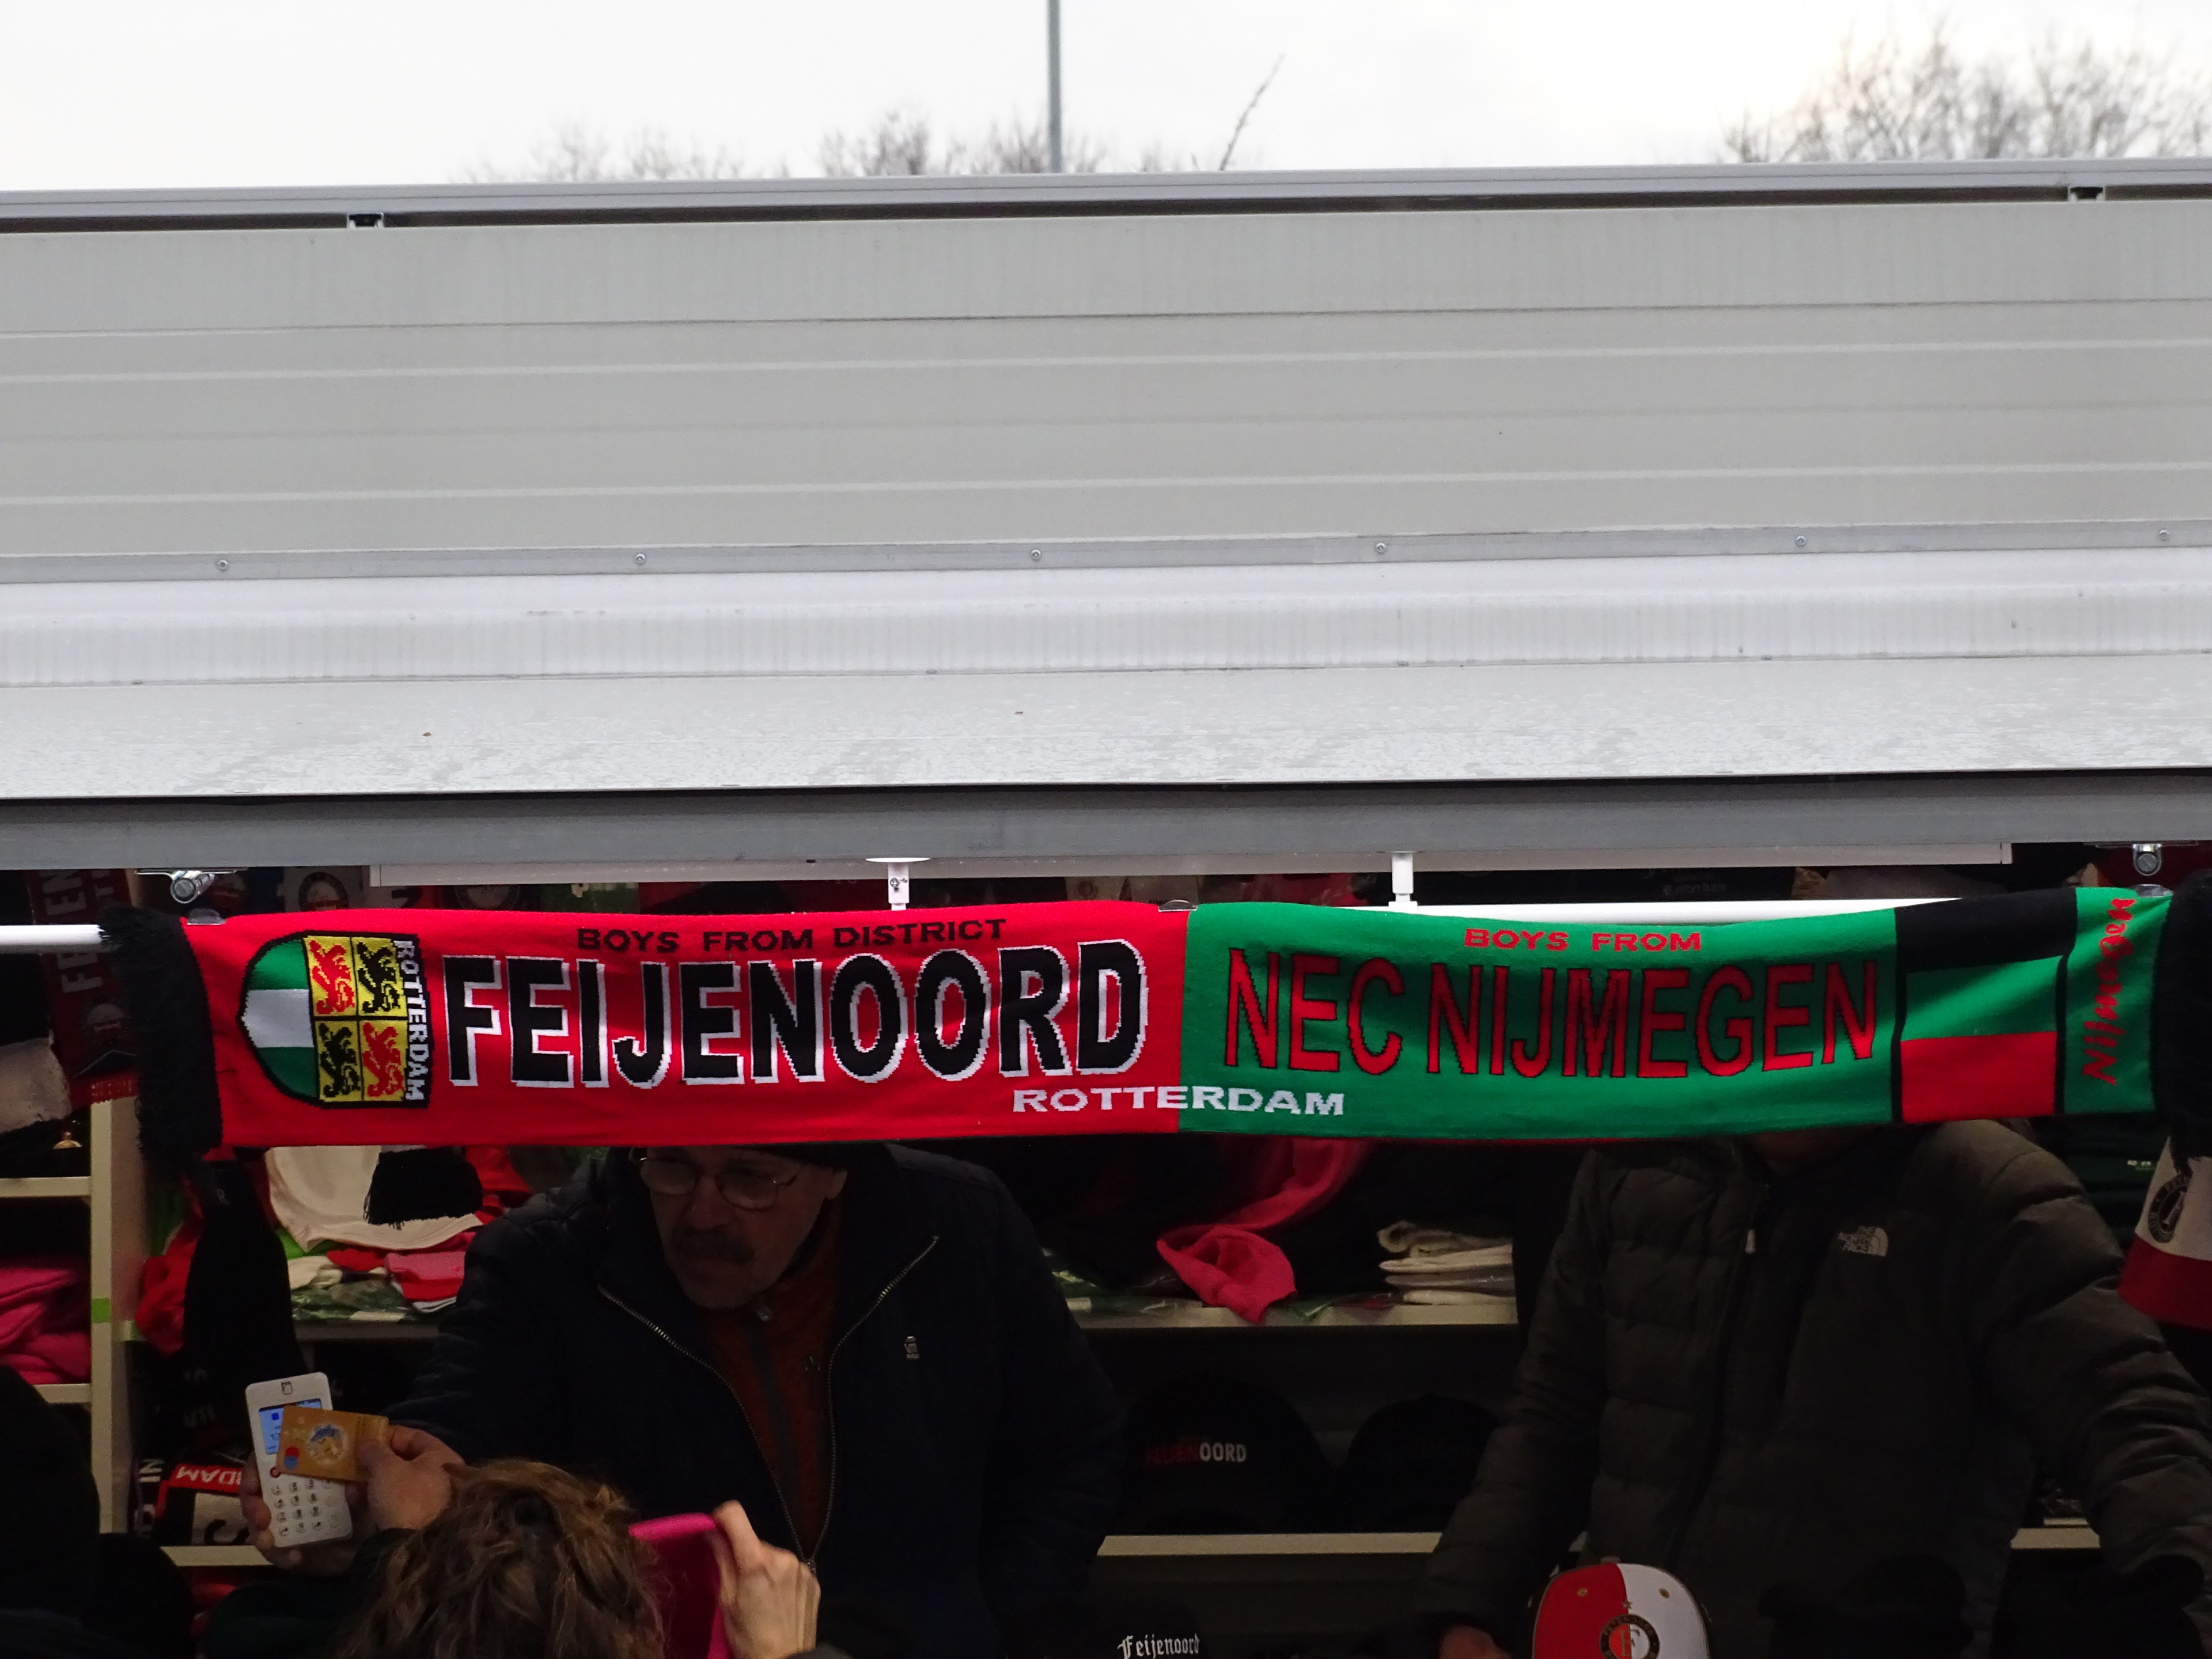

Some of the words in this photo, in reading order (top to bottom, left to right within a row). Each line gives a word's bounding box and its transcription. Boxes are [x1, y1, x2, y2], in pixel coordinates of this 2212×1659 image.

[577, 928, 679, 953] BOYS
[703, 929, 813, 952] FROM
[834, 919, 1006, 948] DISTRICT
[1463, 927, 1569, 952] BOYS
[1590, 932, 1702, 952] FROM
[393, 940, 428, 1101] ROTTERDAM
[442, 938, 1148, 1089] FEIJENOORD
[1224, 948, 1406, 1075] NEC
[1426, 960, 1878, 1078] NIJMEGEN
[1012, 1085, 1344, 1116] ROTTERDAM
[1117, 1633, 1200, 1659] Feijenoord
